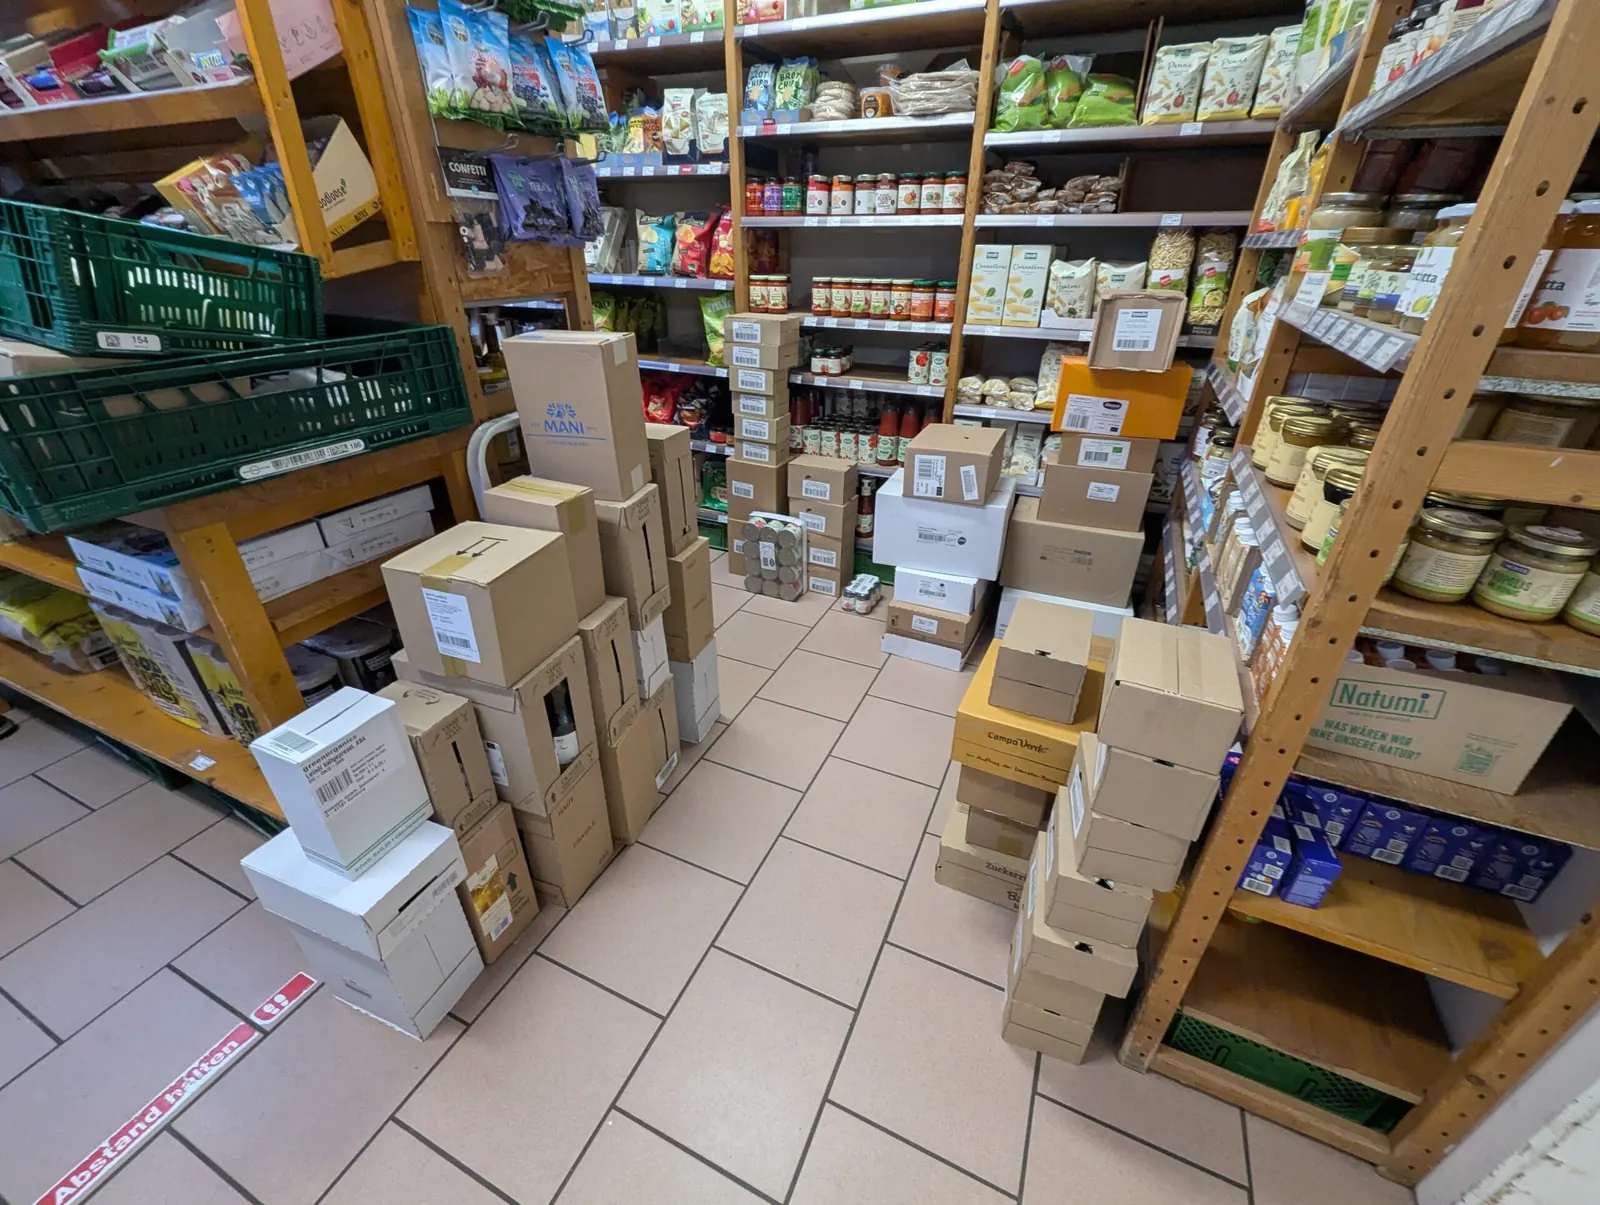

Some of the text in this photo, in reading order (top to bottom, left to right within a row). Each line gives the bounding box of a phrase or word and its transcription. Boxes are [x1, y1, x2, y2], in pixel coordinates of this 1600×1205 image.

[449, 161, 487, 176] CONFETTI
[131, 335, 149, 344] 154
[543, 419, 584, 435] MANI
[1338, 683, 1430, 714] Natumi
[1323, 718, 1414, 747] WAS WÄREN WIR
[1333, 731, 1378, 752] UNSERE
[1377, 743, 1423, 761] NATUR?
[302, 735, 358, 773] greenorganics
[53, 1039, 240, 1204] Abstand halten
